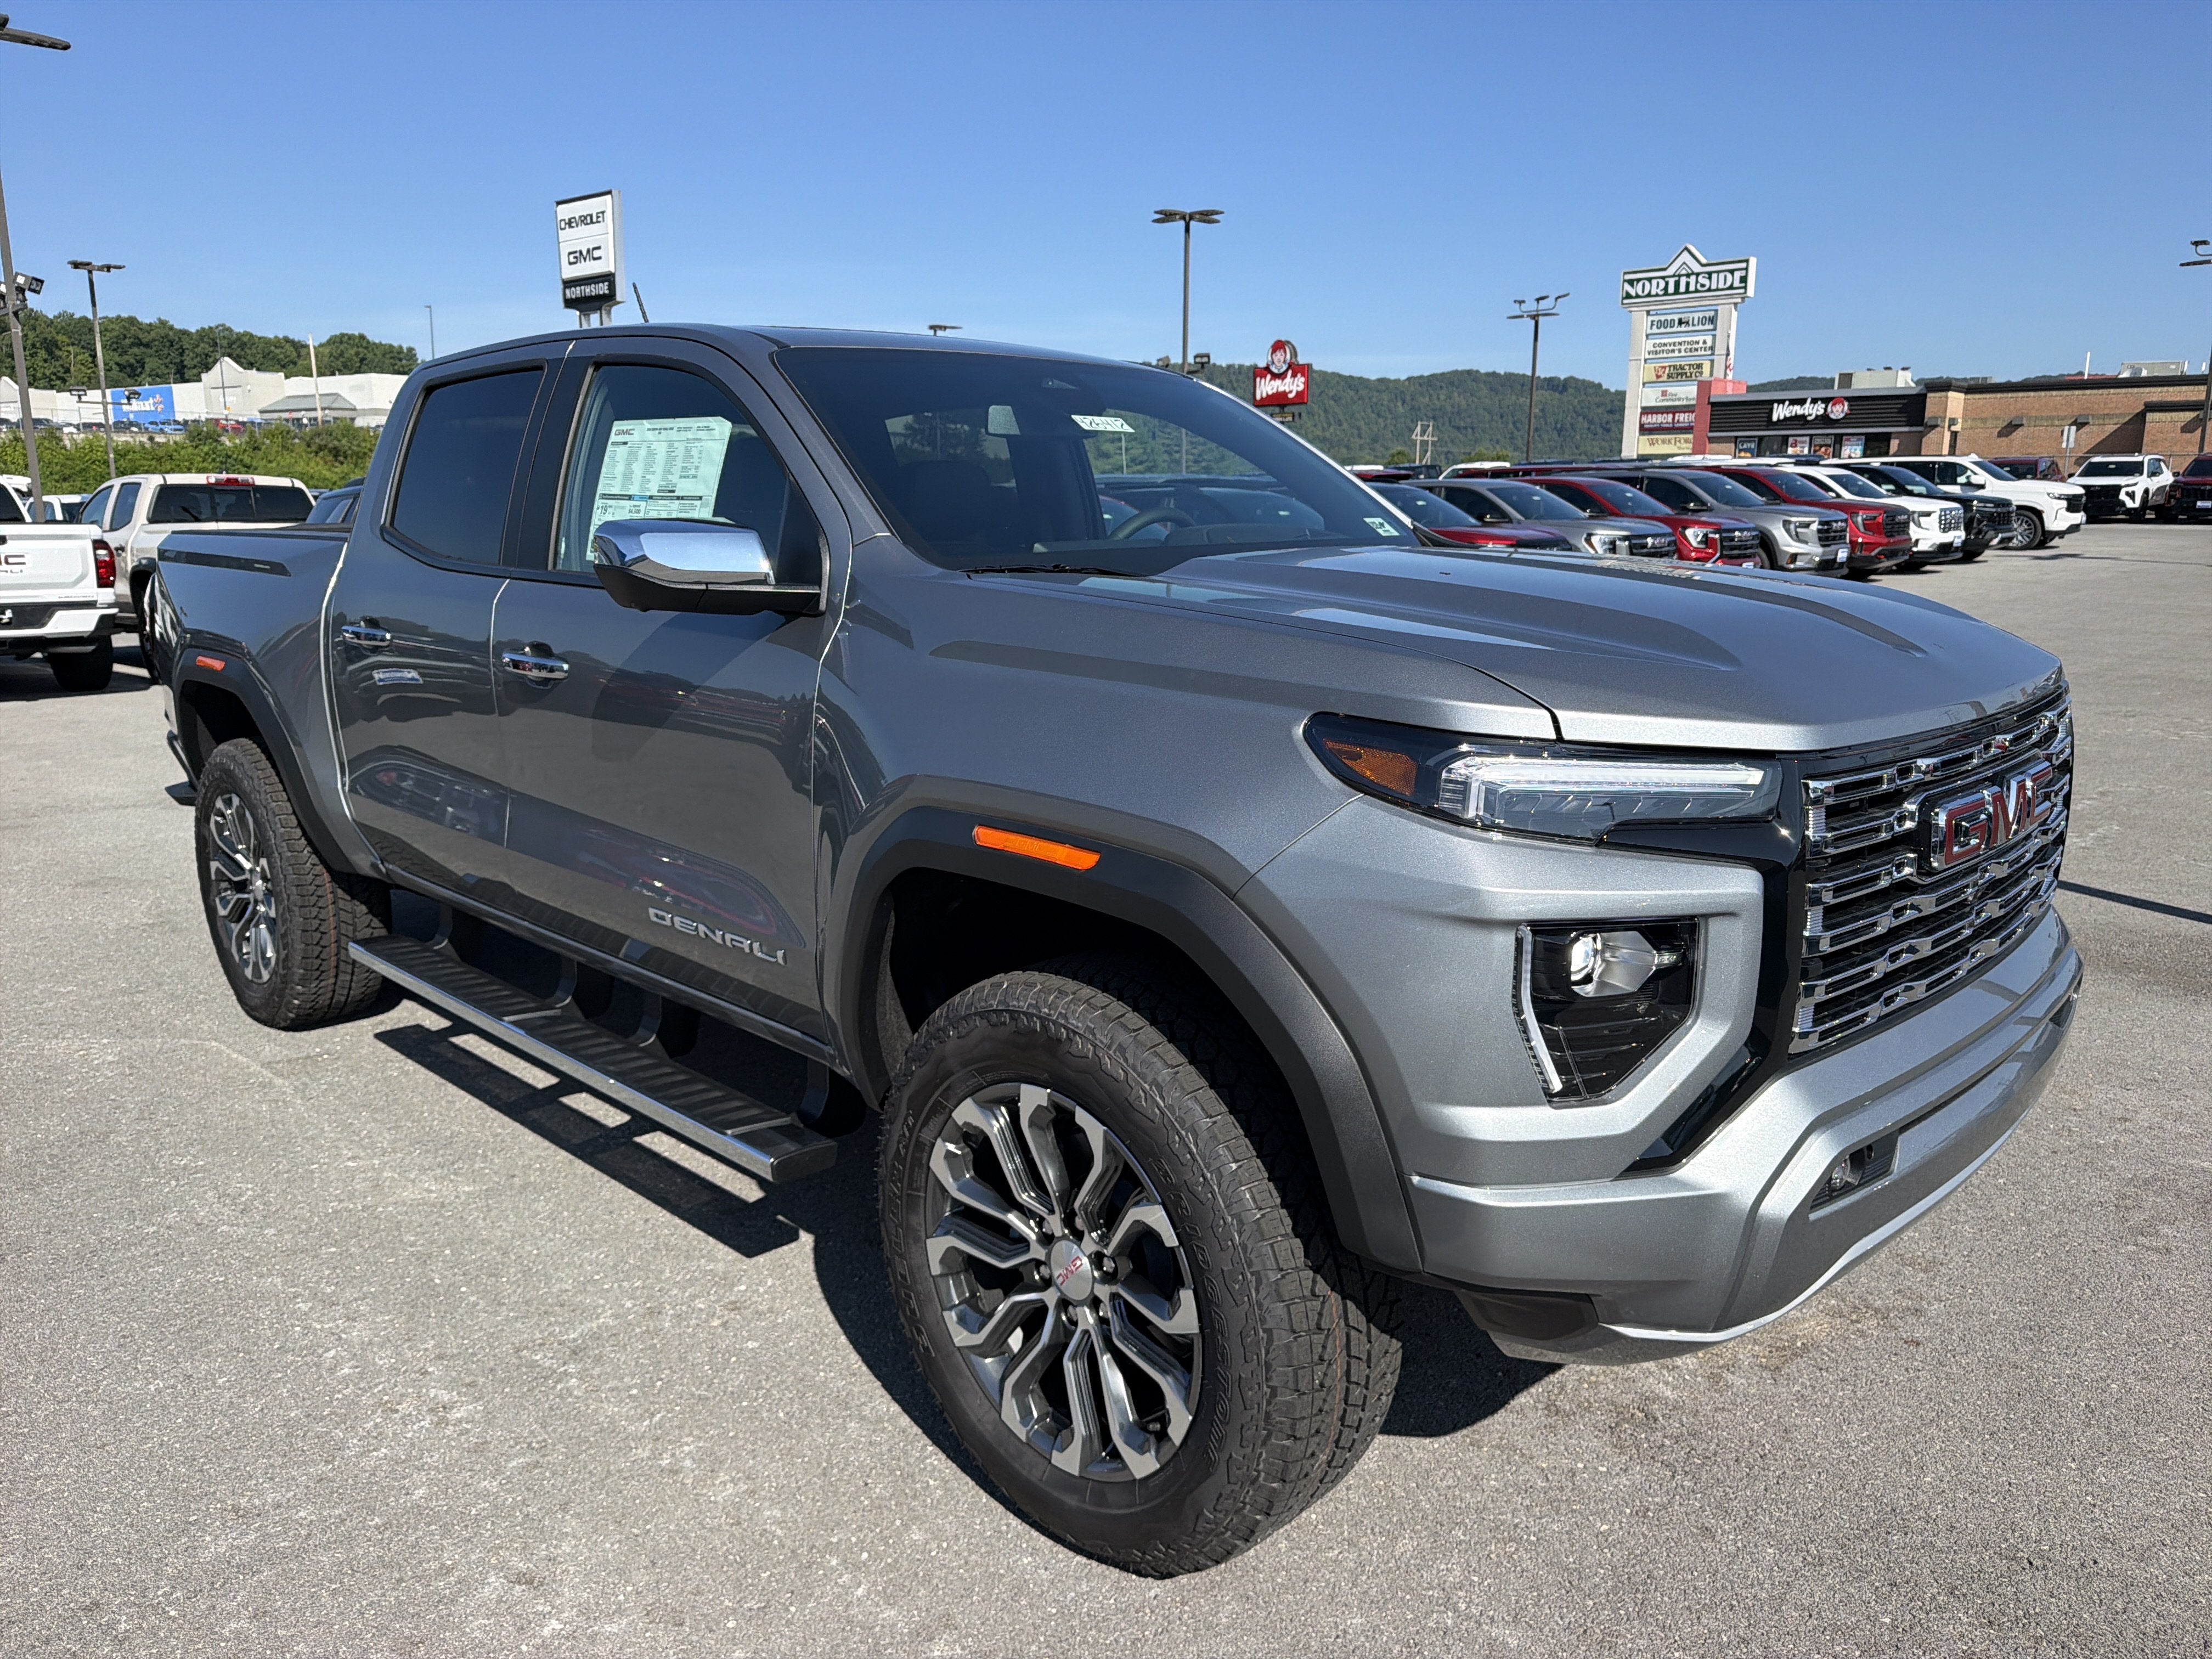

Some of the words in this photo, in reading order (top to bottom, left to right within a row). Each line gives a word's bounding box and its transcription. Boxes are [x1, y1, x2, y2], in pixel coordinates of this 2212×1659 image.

[559, 210, 606, 231] CHEVROLET
[567, 245, 602, 266] GMC
[565, 281, 610, 300] NORTHSIDE
[1623, 271, 1746, 297] NORTHSIDE
[1650, 319, 1675, 330] FOOD
[1691, 315, 1715, 327] LION
[1652, 339, 1700, 348] CONVENTION
[1684, 346, 1713, 354] CENTER
[1667, 371, 1695, 380] SUPPLY
[1668, 362, 1704, 371] TRACTOR
[1255, 369, 1305, 400] Wendy's
[1641, 413, 1673, 424] HARBOR
[1771, 397, 1826, 422] Wendy's
[1074, 417, 1130, 430] 426412
[1646, 437, 1674, 447] WORK
[1931, 761, 2053, 870] GMC
[648, 906, 788, 966] DENALI
[1056, 1255, 1084, 1286] GMC
[1149, 1156, 1232, 1472] BRIDGESTONE
